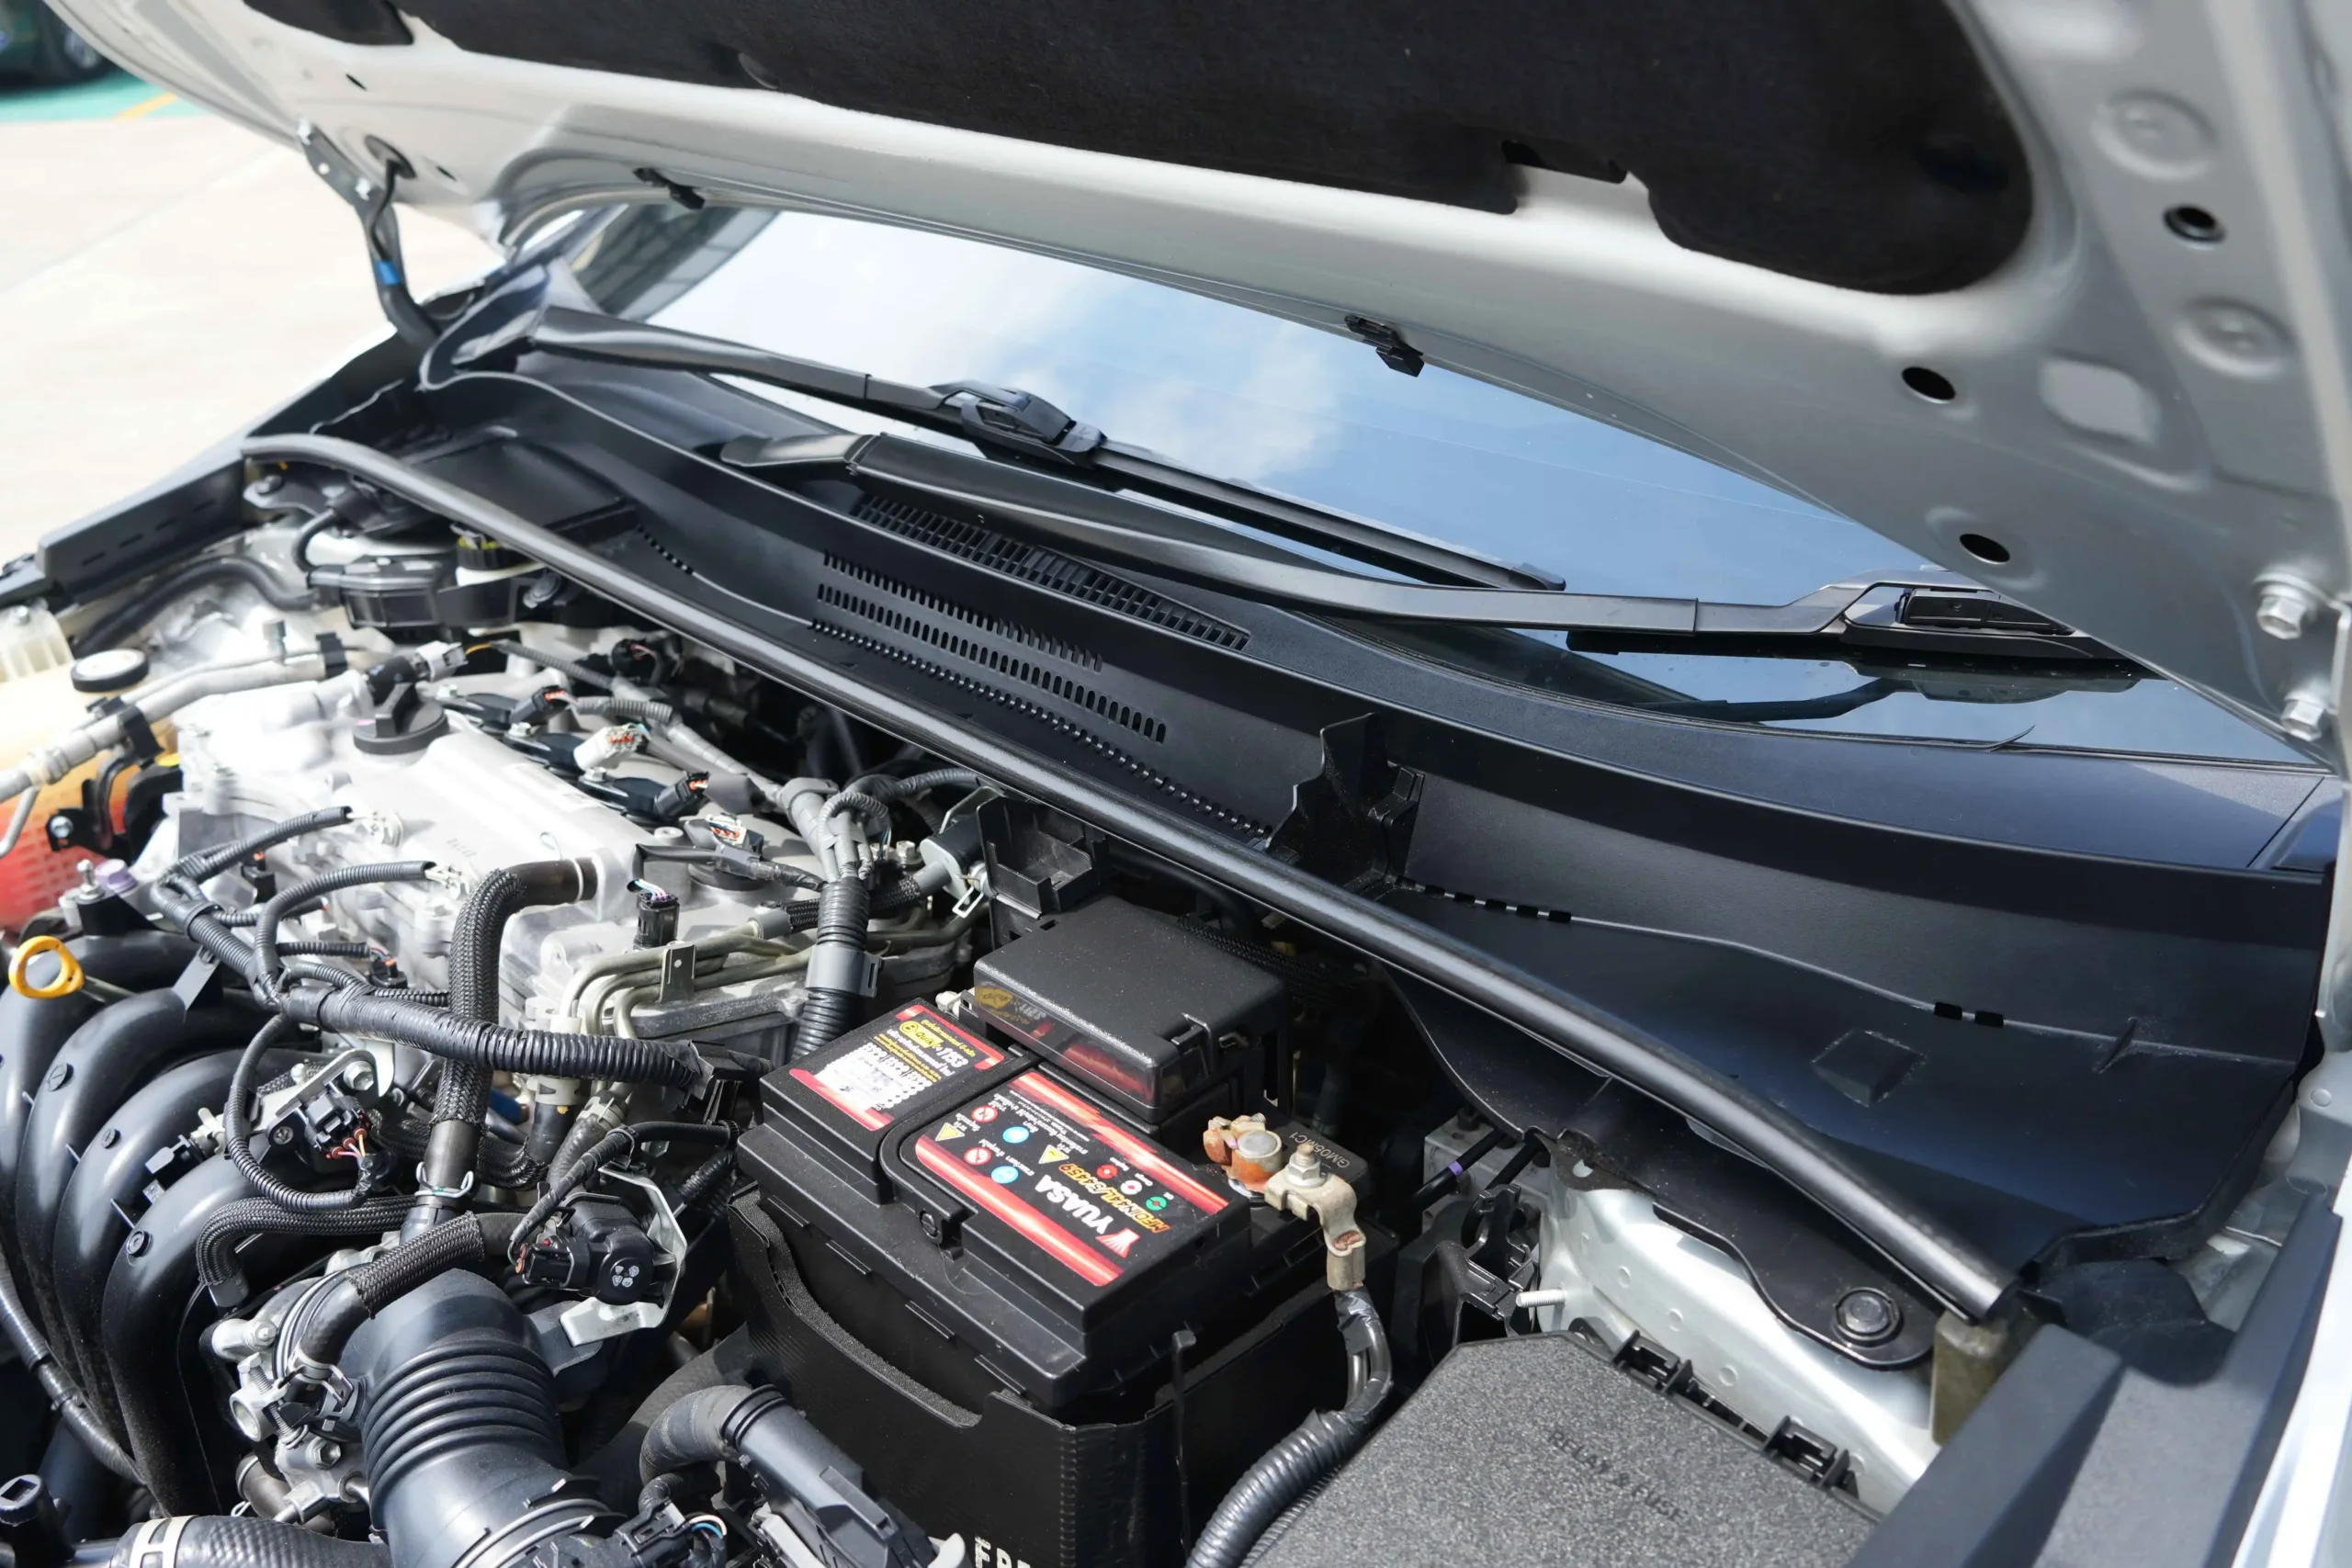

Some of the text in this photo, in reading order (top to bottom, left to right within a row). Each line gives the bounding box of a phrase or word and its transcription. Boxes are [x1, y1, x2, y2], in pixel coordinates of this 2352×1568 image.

[935, 1047, 970, 1068] 1153
[1288, 1130, 1350, 1168] GM05MC1
[1034, 1173, 1114, 1235] YUASA
[1547, 1428, 1612, 1474] RELAY
[1632, 1483, 1689, 1525] FUSE
